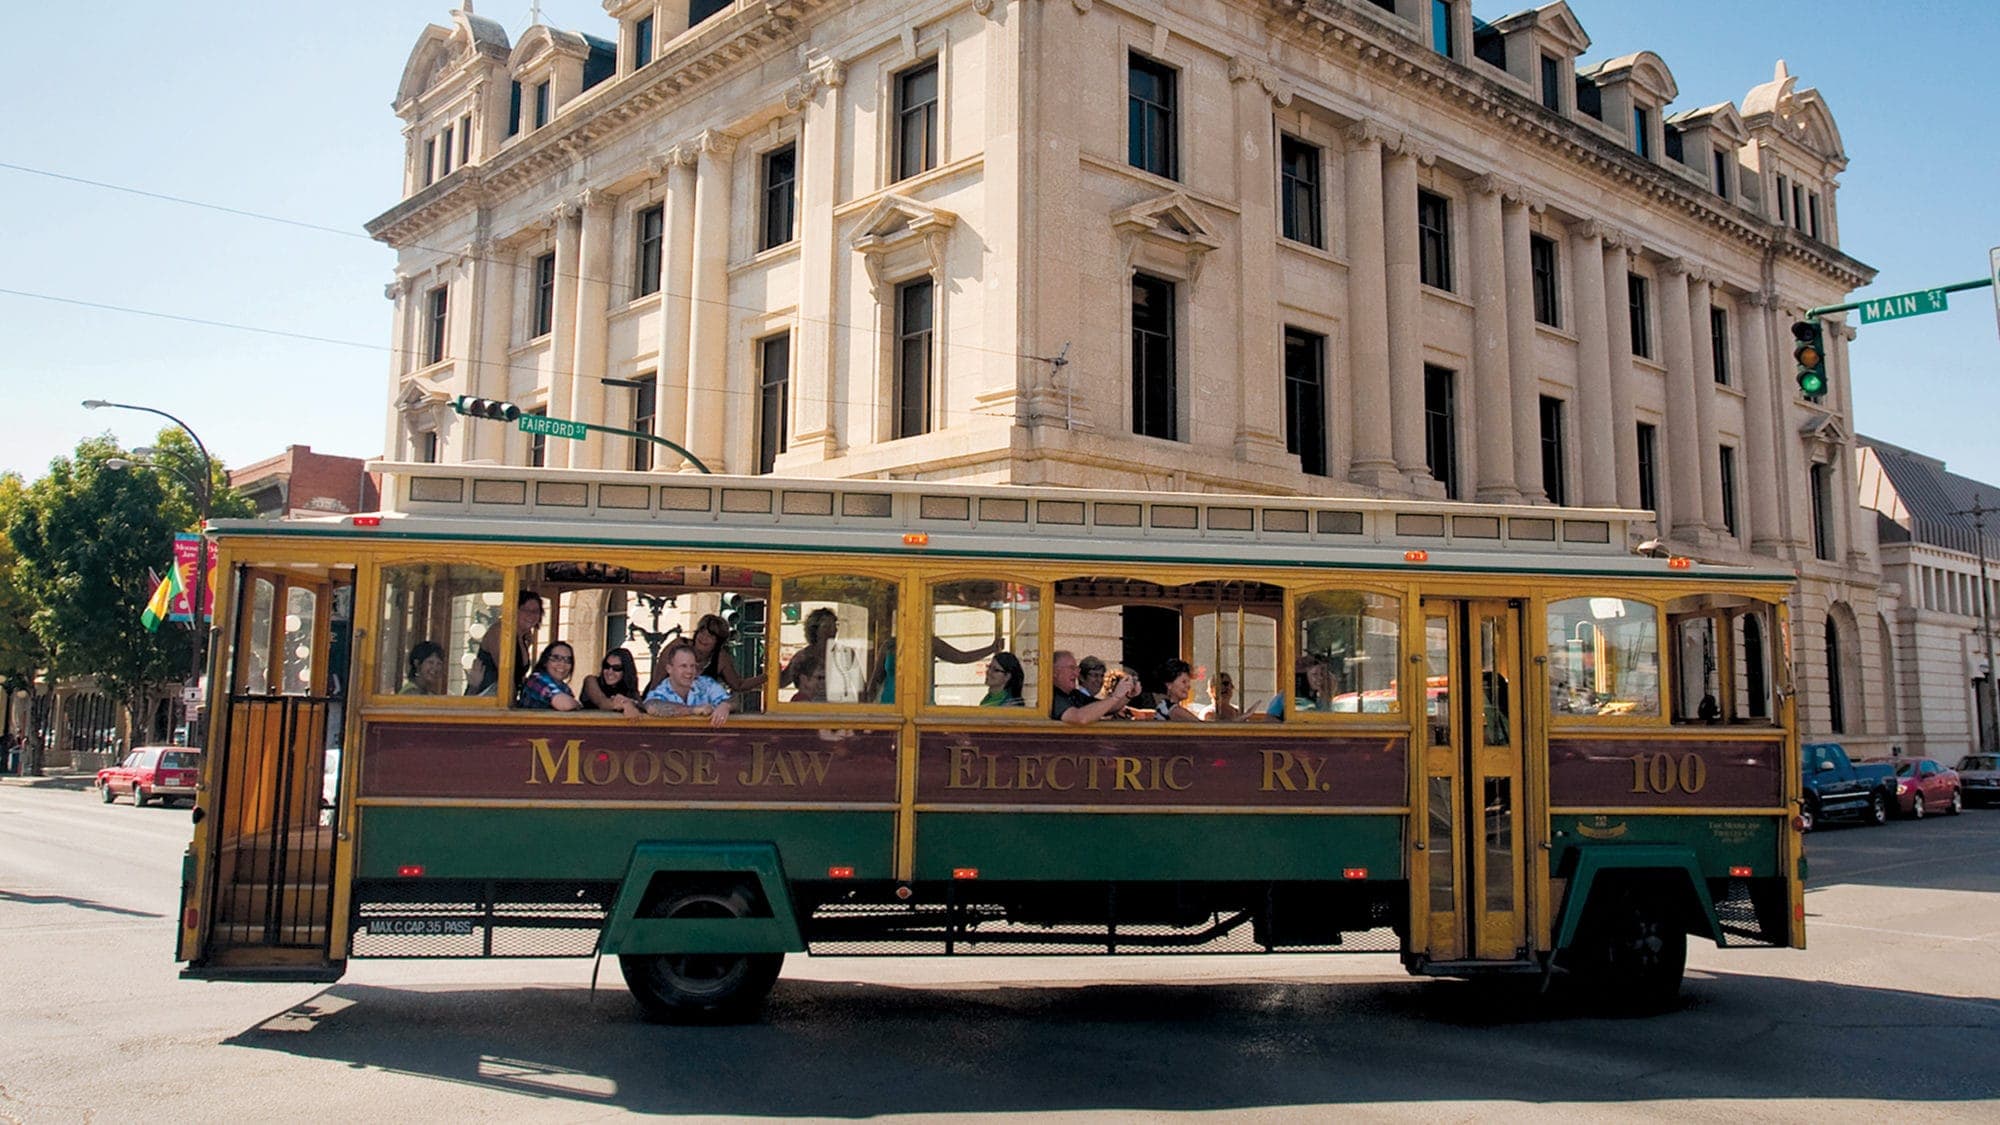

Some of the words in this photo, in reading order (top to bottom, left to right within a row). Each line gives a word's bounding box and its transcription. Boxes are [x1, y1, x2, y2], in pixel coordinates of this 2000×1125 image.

[1866, 295, 1917, 321] MAIN
[1927, 290, 1942, 301] ST
[1932, 300, 1941, 309] N
[521, 417, 575, 436] FAIRFORD
[575, 425, 586, 434] ST
[526, 738, 720, 786] MOOSE
[737, 741, 834, 787] JAW
[943, 745, 1195, 791] ELECTRIC
[1257, 748, 1331, 792] RY.
[1630, 752, 1707, 794] 100
[426, 921, 441, 932] 35
[444, 921, 471, 932] PASS
